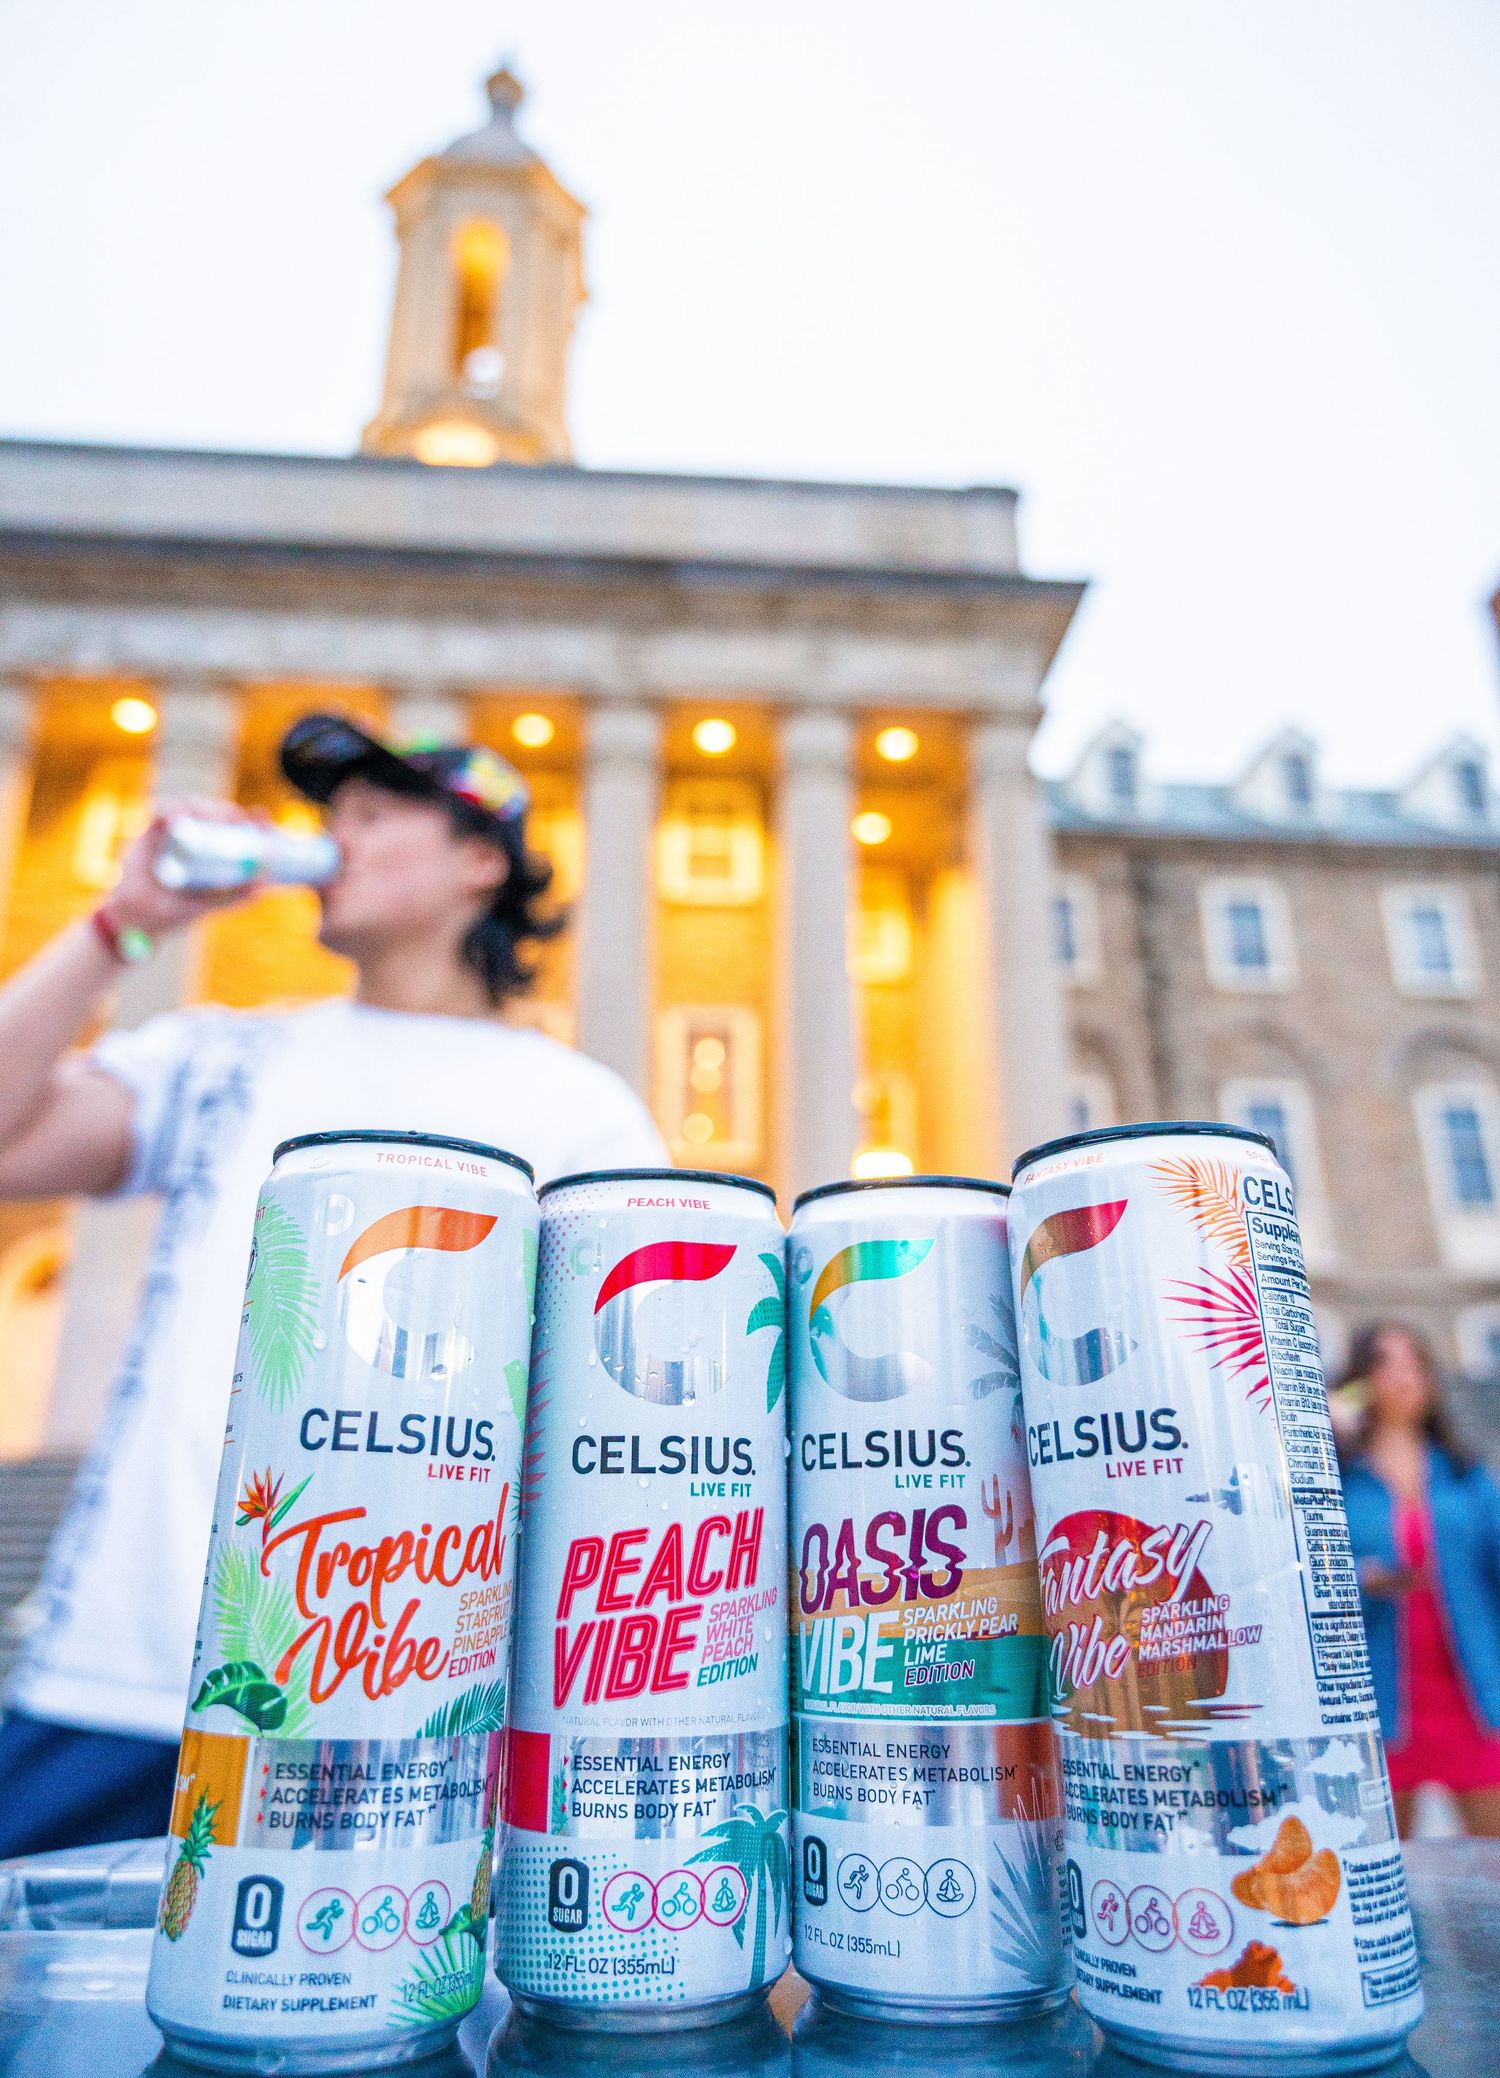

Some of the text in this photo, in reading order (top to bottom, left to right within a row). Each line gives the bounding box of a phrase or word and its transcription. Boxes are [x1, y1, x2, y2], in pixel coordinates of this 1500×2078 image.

[377, 1153, 488, 1177] TROPICAL VIBE
[1024, 1153, 1104, 1184] FANTASY VIBE
[627, 1197, 711, 1210] PEACH VIBE
[1255, 1239, 1280, 1254] Serving
[1258, 1251, 1287, 1265] Servings
[1261, 1274, 1291, 1288] Amount
[1262, 1290, 1288, 1302] Calories
[1265, 1304, 1280, 1316] Total
[1274, 1320, 1288, 1330] Total
[1269, 1335, 1291, 1346] Vitamin
[1274, 1365, 1294, 1376] Niacin
[1277, 1380, 1298, 1392] Vitamin
[1278, 1396, 1300, 1407] Vitamin
[1285, 1442, 1310, 1453] Calcium
[428, 1463, 490, 1483] LIVE FIT
[1106, 1458, 1184, 1479] LIVE FIT
[1290, 1474, 1314, 1484] Sodium
[690, 1482, 752, 1498] LIVE FIT
[895, 1474, 965, 1489] LIVE FIT
[261, 1482, 508, 1629] Tropical
[555, 1505, 766, 1621] PEACH
[799, 1504, 968, 1614] OASIS
[708, 1586, 778, 1622] SPARKLING
[902, 1596, 998, 1627] SPARKLING
[1142, 1594, 1230, 1624] SPARKLING
[706, 1614, 754, 1643] WHITE
[903, 1613, 1018, 1647] PRICKLY PEAR
[1140, 1613, 1225, 1642] MANDARIN
[274, 1598, 450, 1704] Vibe
[701, 1634, 753, 1664] PEACH
[799, 1610, 900, 1695] VIBE
[1138, 1624, 1262, 1661] MARSHMALLOW
[448, 1647, 496, 1678] EDITION
[552, 1604, 704, 1710] VIBE
[904, 1644, 947, 1668] LIME
[1049, 1615, 1132, 1701] Vibe
[1137, 1655, 1197, 1678] EDITION
[696, 1653, 758, 1687] EDITION
[904, 1659, 975, 1687] EDITION
[641, 1718, 664, 1726] WITH
[666, 1716, 697, 1726] OTHER
[699, 1714, 734, 1725] NATURAL
[882, 1704, 911, 1714] OTHER
[914, 1704, 956, 1716] NATURAL
[958, 1704, 995, 1716] FLAVORS
[812, 1738, 950, 1759] ESSENTIAL ENERGY
[274, 1761, 448, 1781] ESSENTIAL ENERGY
[573, 1752, 730, 1772] ESSENTIAL ENERGY
[812, 1760, 1016, 1782] ACCELERATES METABOLISM
[572, 1769, 776, 1796] ACCELERATES METABOLISM
[1123, 1764, 1192, 1783] ENERGY
[272, 1787, 403, 1804] ACCELERATES
[813, 1782, 931, 1806] BURNS BODY FAT
[1154, 1790, 1276, 1808] METABOLISM
[269, 1810, 425, 1830] BURNS BODY FAT
[572, 1800, 712, 1819] BURNS BODY FAT
[1067, 1804, 1175, 1831] BURNS BODY FAT
[807, 1842, 820, 1881] 0
[558, 1866, 579, 1906] 0
[805, 1880, 824, 1900] SUGAR
[246, 1882, 272, 1928] 0
[553, 1906, 582, 1924] SUGAR
[237, 1929, 272, 1948] SUGAR
[804, 1924, 813, 1941] 12
[830, 1932, 844, 1950] OZ
[848, 1934, 900, 1958] (355mL)
[548, 1952, 562, 1970] 12
[588, 1958, 609, 1974] OZ
[613, 1956, 675, 1976] (355mL)
[1101, 1956, 1137, 1978] PROVEN
[226, 1970, 352, 1986] CLINICALLY PROVEN
[1096, 1978, 1162, 2004] SUPPLEMENT
[1187, 1986, 1202, 2009] 12
[1226, 1988, 1248, 2011] OZ
[223, 1994, 378, 2012] DIETARY SUPPLEMENT
